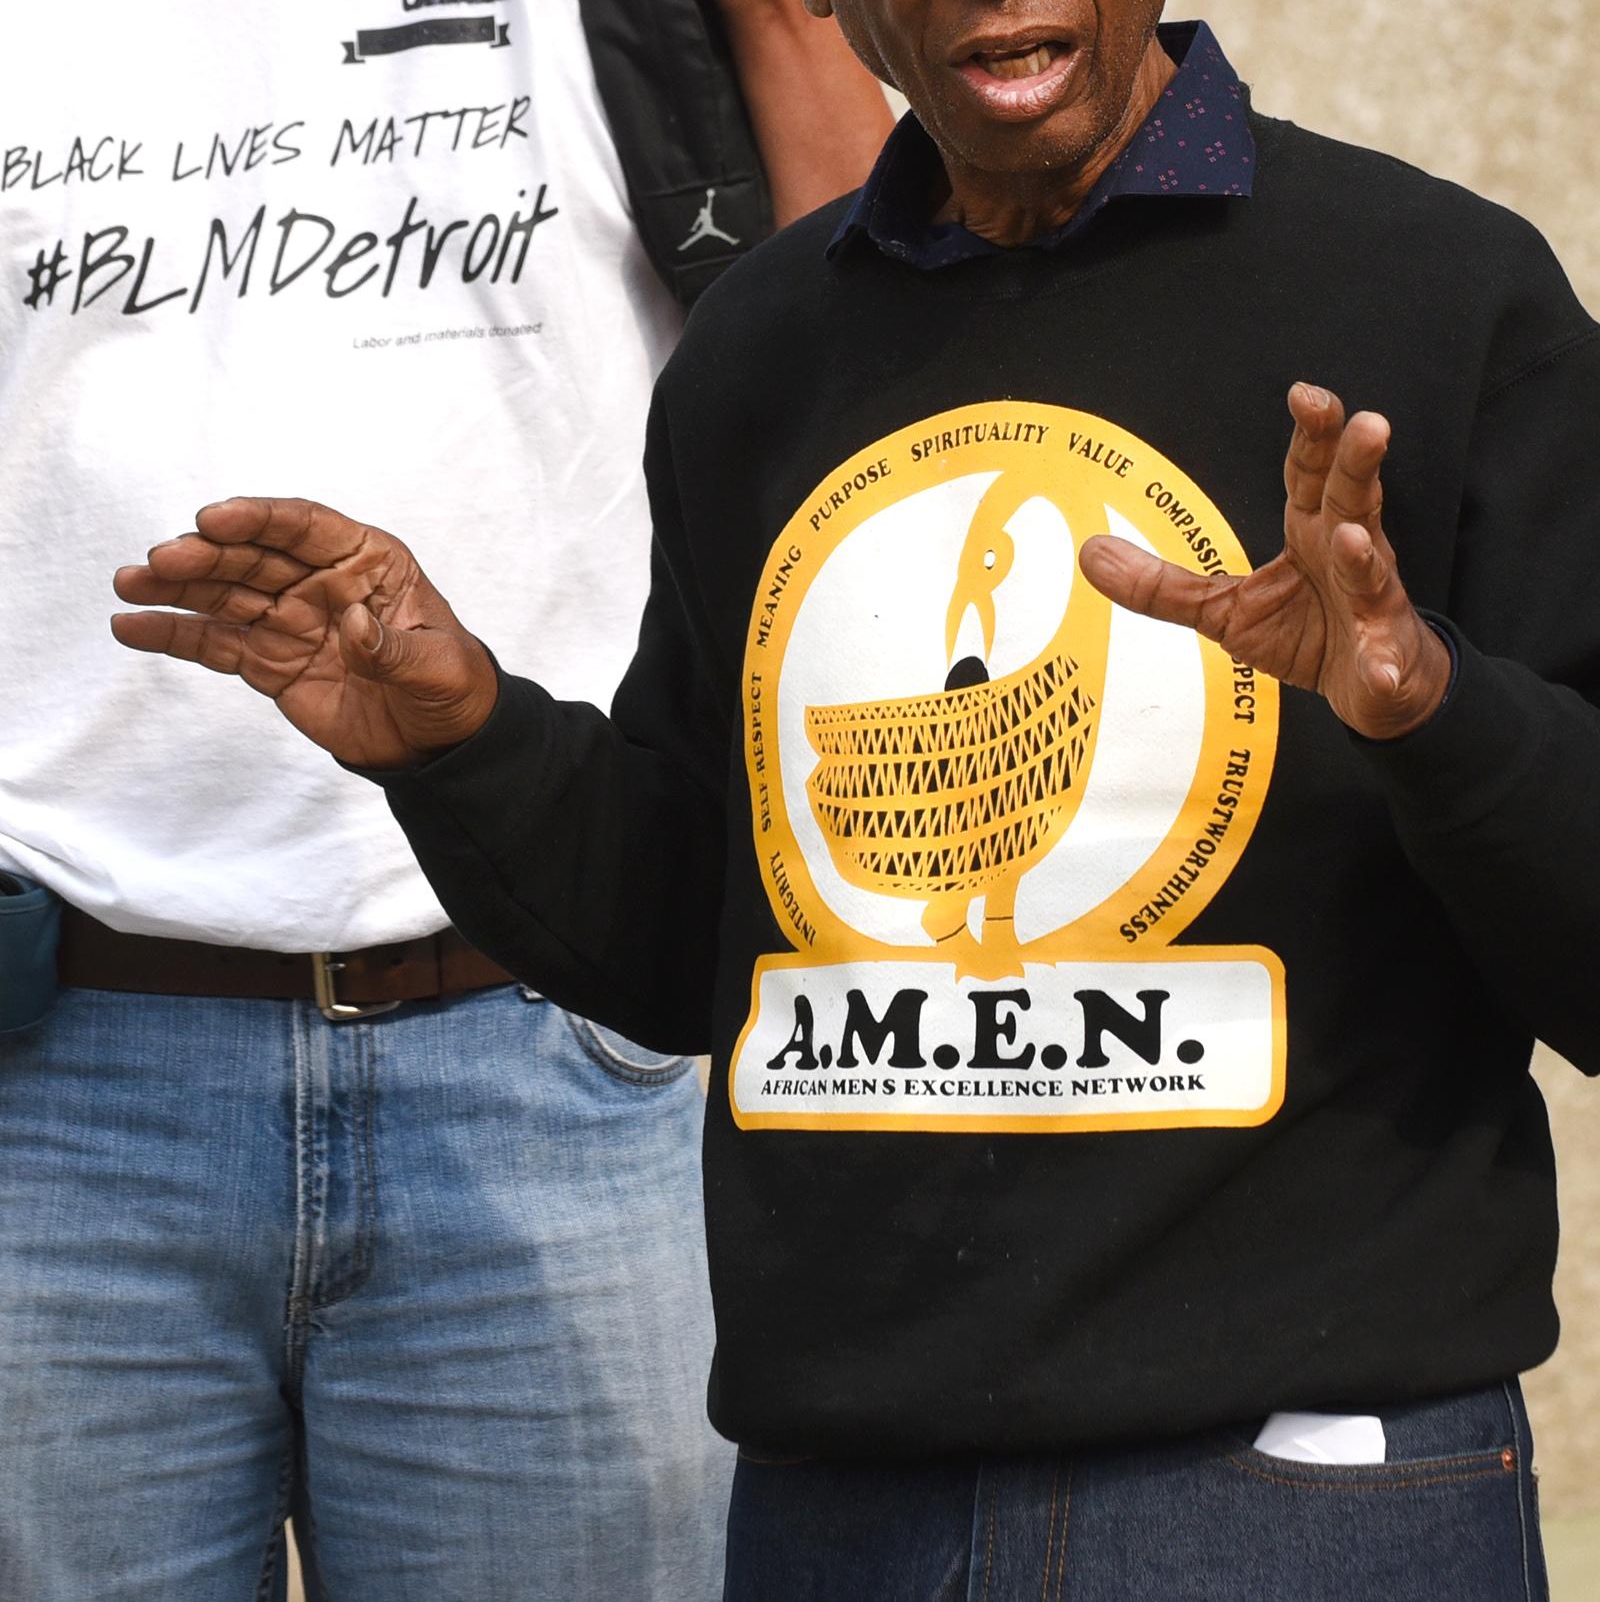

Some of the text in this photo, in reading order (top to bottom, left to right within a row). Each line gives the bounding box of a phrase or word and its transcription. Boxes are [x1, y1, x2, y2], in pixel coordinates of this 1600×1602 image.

[0, 95, 532, 192] BLACK LIVES MATTER
[23, 183, 559, 316] #BLMDetroit
[352, 322, 543, 349] Labor and materials donated
[909, 421, 1050, 463] SPIRITUALITY
[1067, 432, 1135, 478] VALUE
[809, 457, 893, 532] PURPOSE
[756, 544, 802, 649] MEANING
[751, 670, 772, 832] SELF-RESPECT
[1119, 749, 1251, 943] TRUSTWORTHINESS
[770, 850, 816, 948] INTEGRITY
[765, 988, 1205, 1071] A.M.E.N.
[761, 1078, 827, 1096] AFRICAN
[904, 1078, 1064, 1097] EXCELLENCE
[1071, 1074, 1207, 1096] NETWORK
